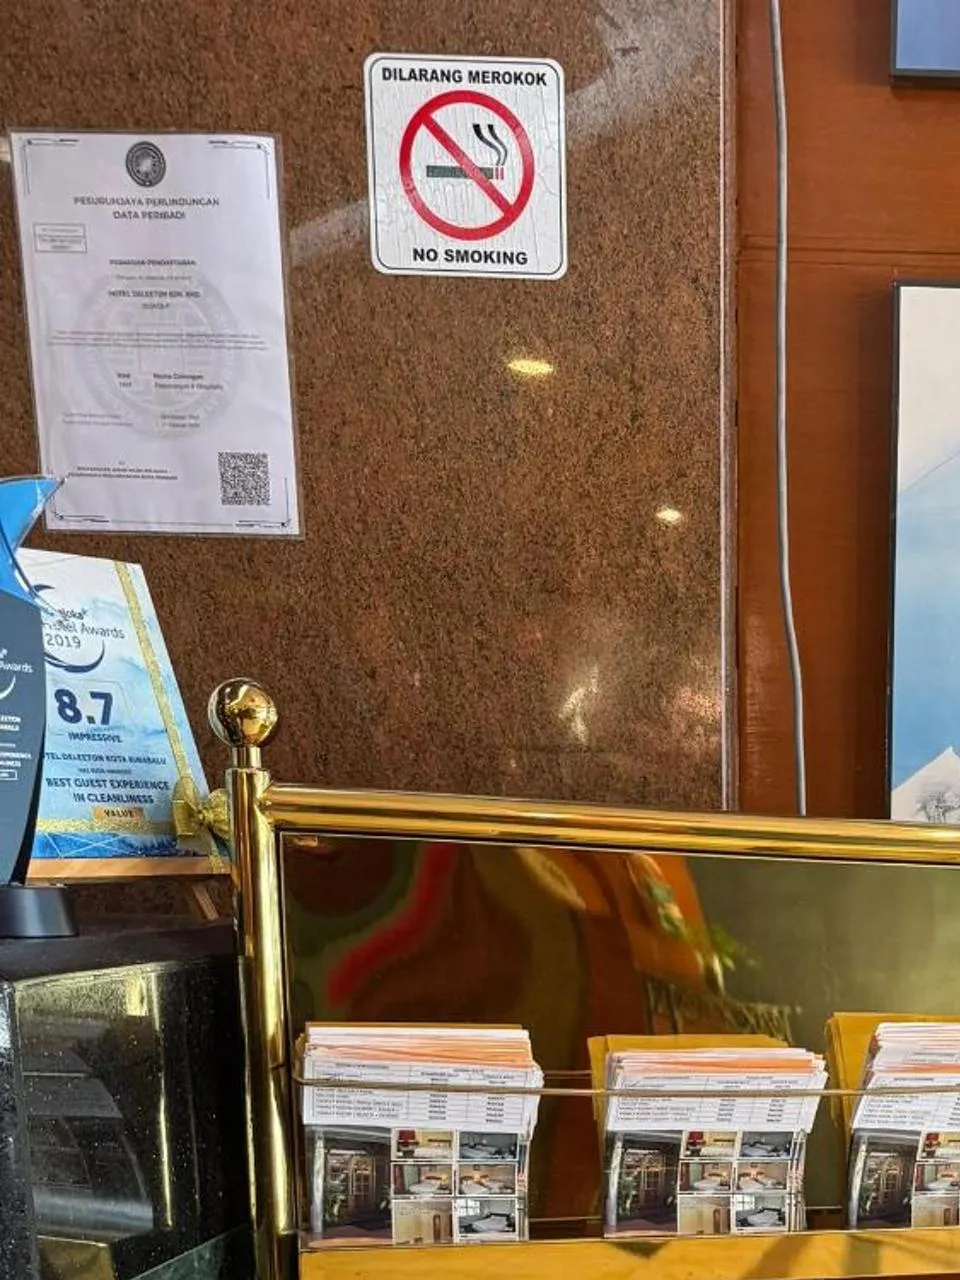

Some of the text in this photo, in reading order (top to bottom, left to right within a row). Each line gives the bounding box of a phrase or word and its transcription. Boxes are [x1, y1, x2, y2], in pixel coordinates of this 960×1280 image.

[382, 67, 547, 86] DILARANG MEROKOK
[113, 211, 138, 219] DATA
[413, 248, 529, 264] NO SMOKING
[80, 624, 126, 639] Awards
[45, 633, 81, 649] 2019
[54, 688, 114, 726] 8.7
[68, 731, 123, 743] IMPRESSIVE
[105, 755, 127, 764] KOTA
[46, 777, 171, 791] BEST GUEST EXPERIENCE
[73, 793, 155, 805] IN CLEANLINESS
